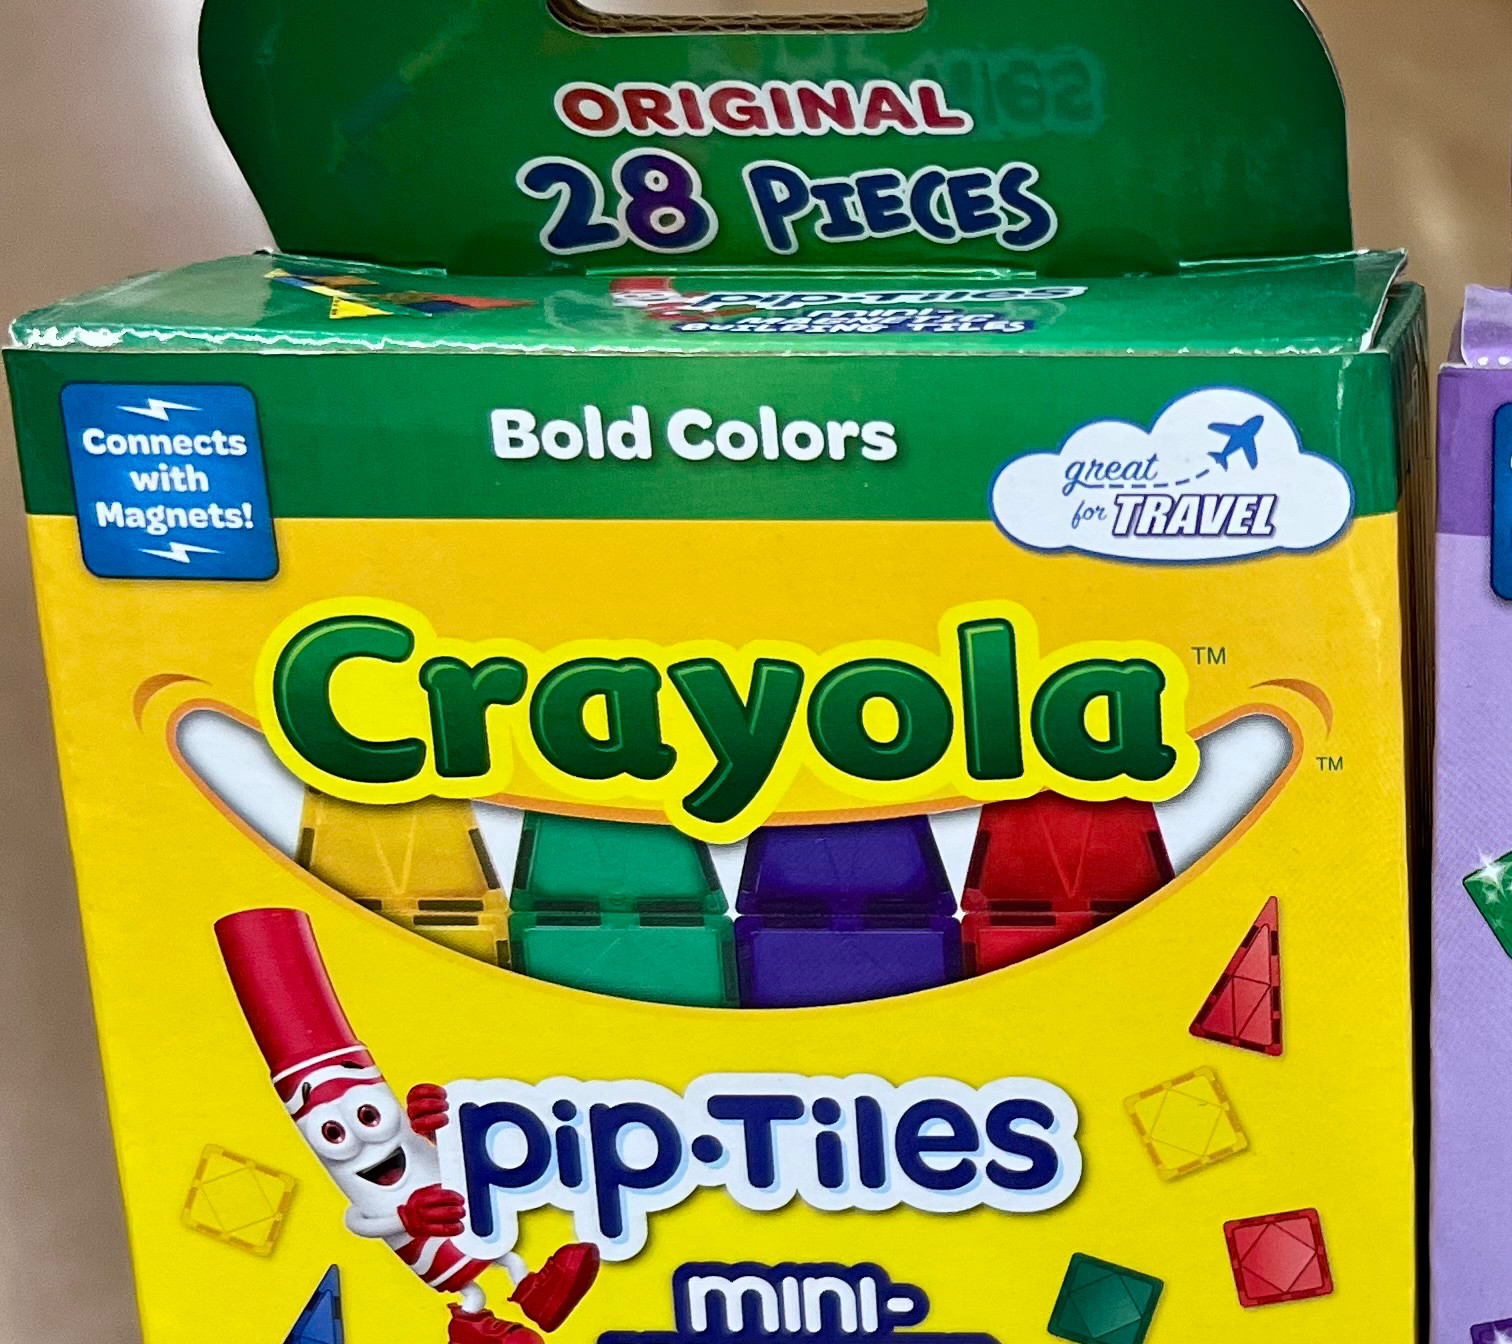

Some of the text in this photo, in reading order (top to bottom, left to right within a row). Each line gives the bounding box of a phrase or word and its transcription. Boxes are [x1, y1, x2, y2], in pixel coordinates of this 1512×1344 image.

[553, 81, 973, 136] ORIGINAL
[516, 147, 1058, 255] 28 PIECES
[82, 428, 248, 456] Connects
[490, 405, 898, 462] Bold Colors
[129, 463, 209, 492] with
[1062, 453, 1158, 496] great
[95, 501, 253, 535] Magnets!
[1071, 494, 1277, 537] for TRAVEL
[272, 615, 1178, 824] Crayola
[689, 1276, 915, 1333] mini-
